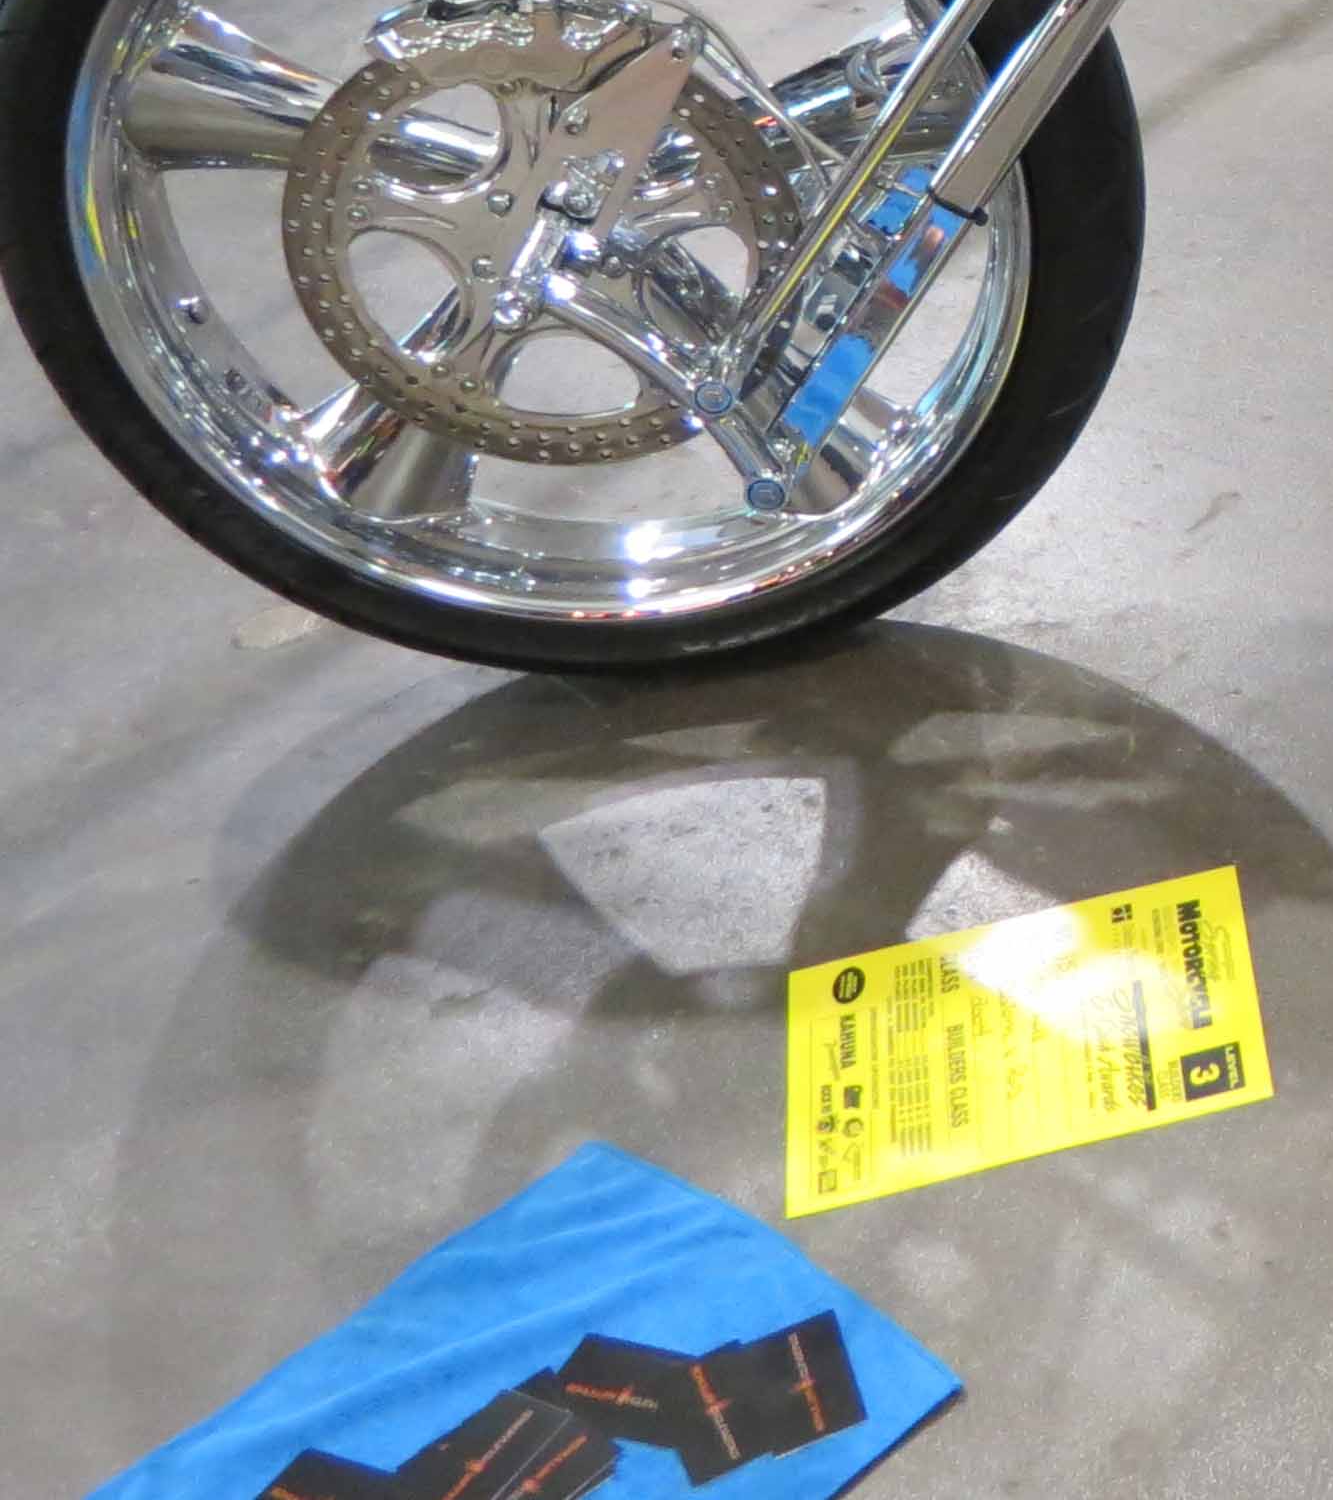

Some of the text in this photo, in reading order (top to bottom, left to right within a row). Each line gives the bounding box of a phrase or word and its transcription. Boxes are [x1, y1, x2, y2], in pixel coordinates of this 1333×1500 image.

[839, 1013, 857, 1071] KAHUNA
[1225, 1046, 1241, 1088] LEVEL
[947, 1024, 968, 1129] BUILDERS CLASS
[1189, 1062, 1221, 1087] 3
